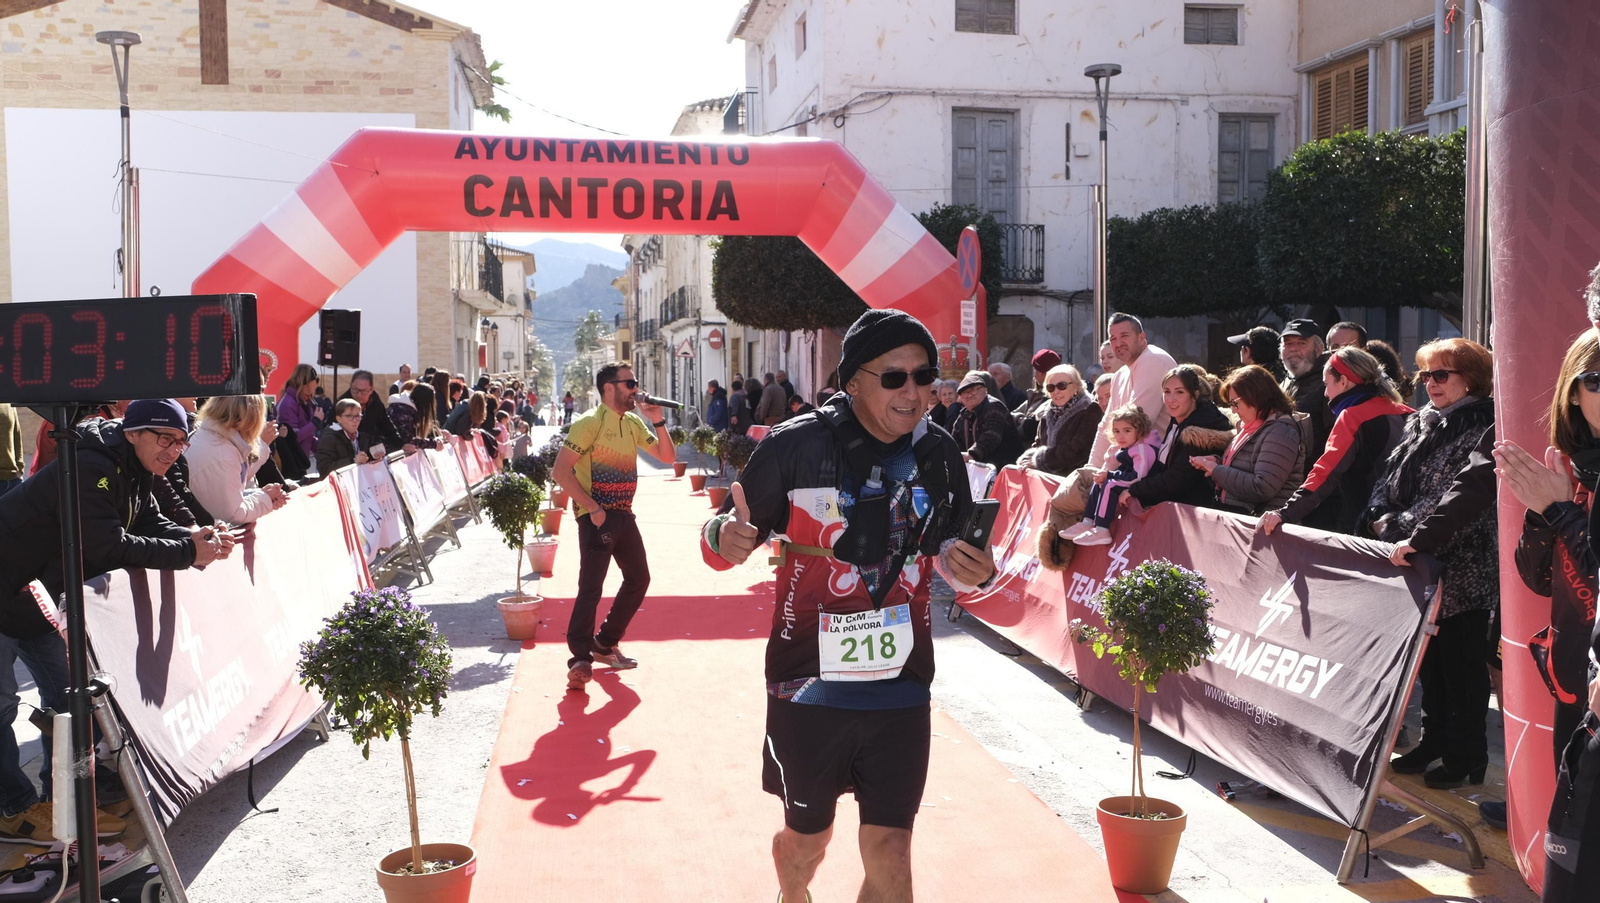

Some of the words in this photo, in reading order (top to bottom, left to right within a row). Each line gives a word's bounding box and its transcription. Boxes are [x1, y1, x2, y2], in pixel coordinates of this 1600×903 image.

[454, 136, 750, 166] AYUNTAMIENTO
[463, 174, 740, 221] CANTORIA
[829, 625, 841, 634] LA
[842, 620, 882, 634] PÓLVORA
[833, 615, 842, 624] IV
[845, 612, 866, 624] CxM
[840, 631, 897, 662] 218
[162, 655, 250, 758] TEAMERGY
[1204, 683, 1278, 727] www.teamergy.es
